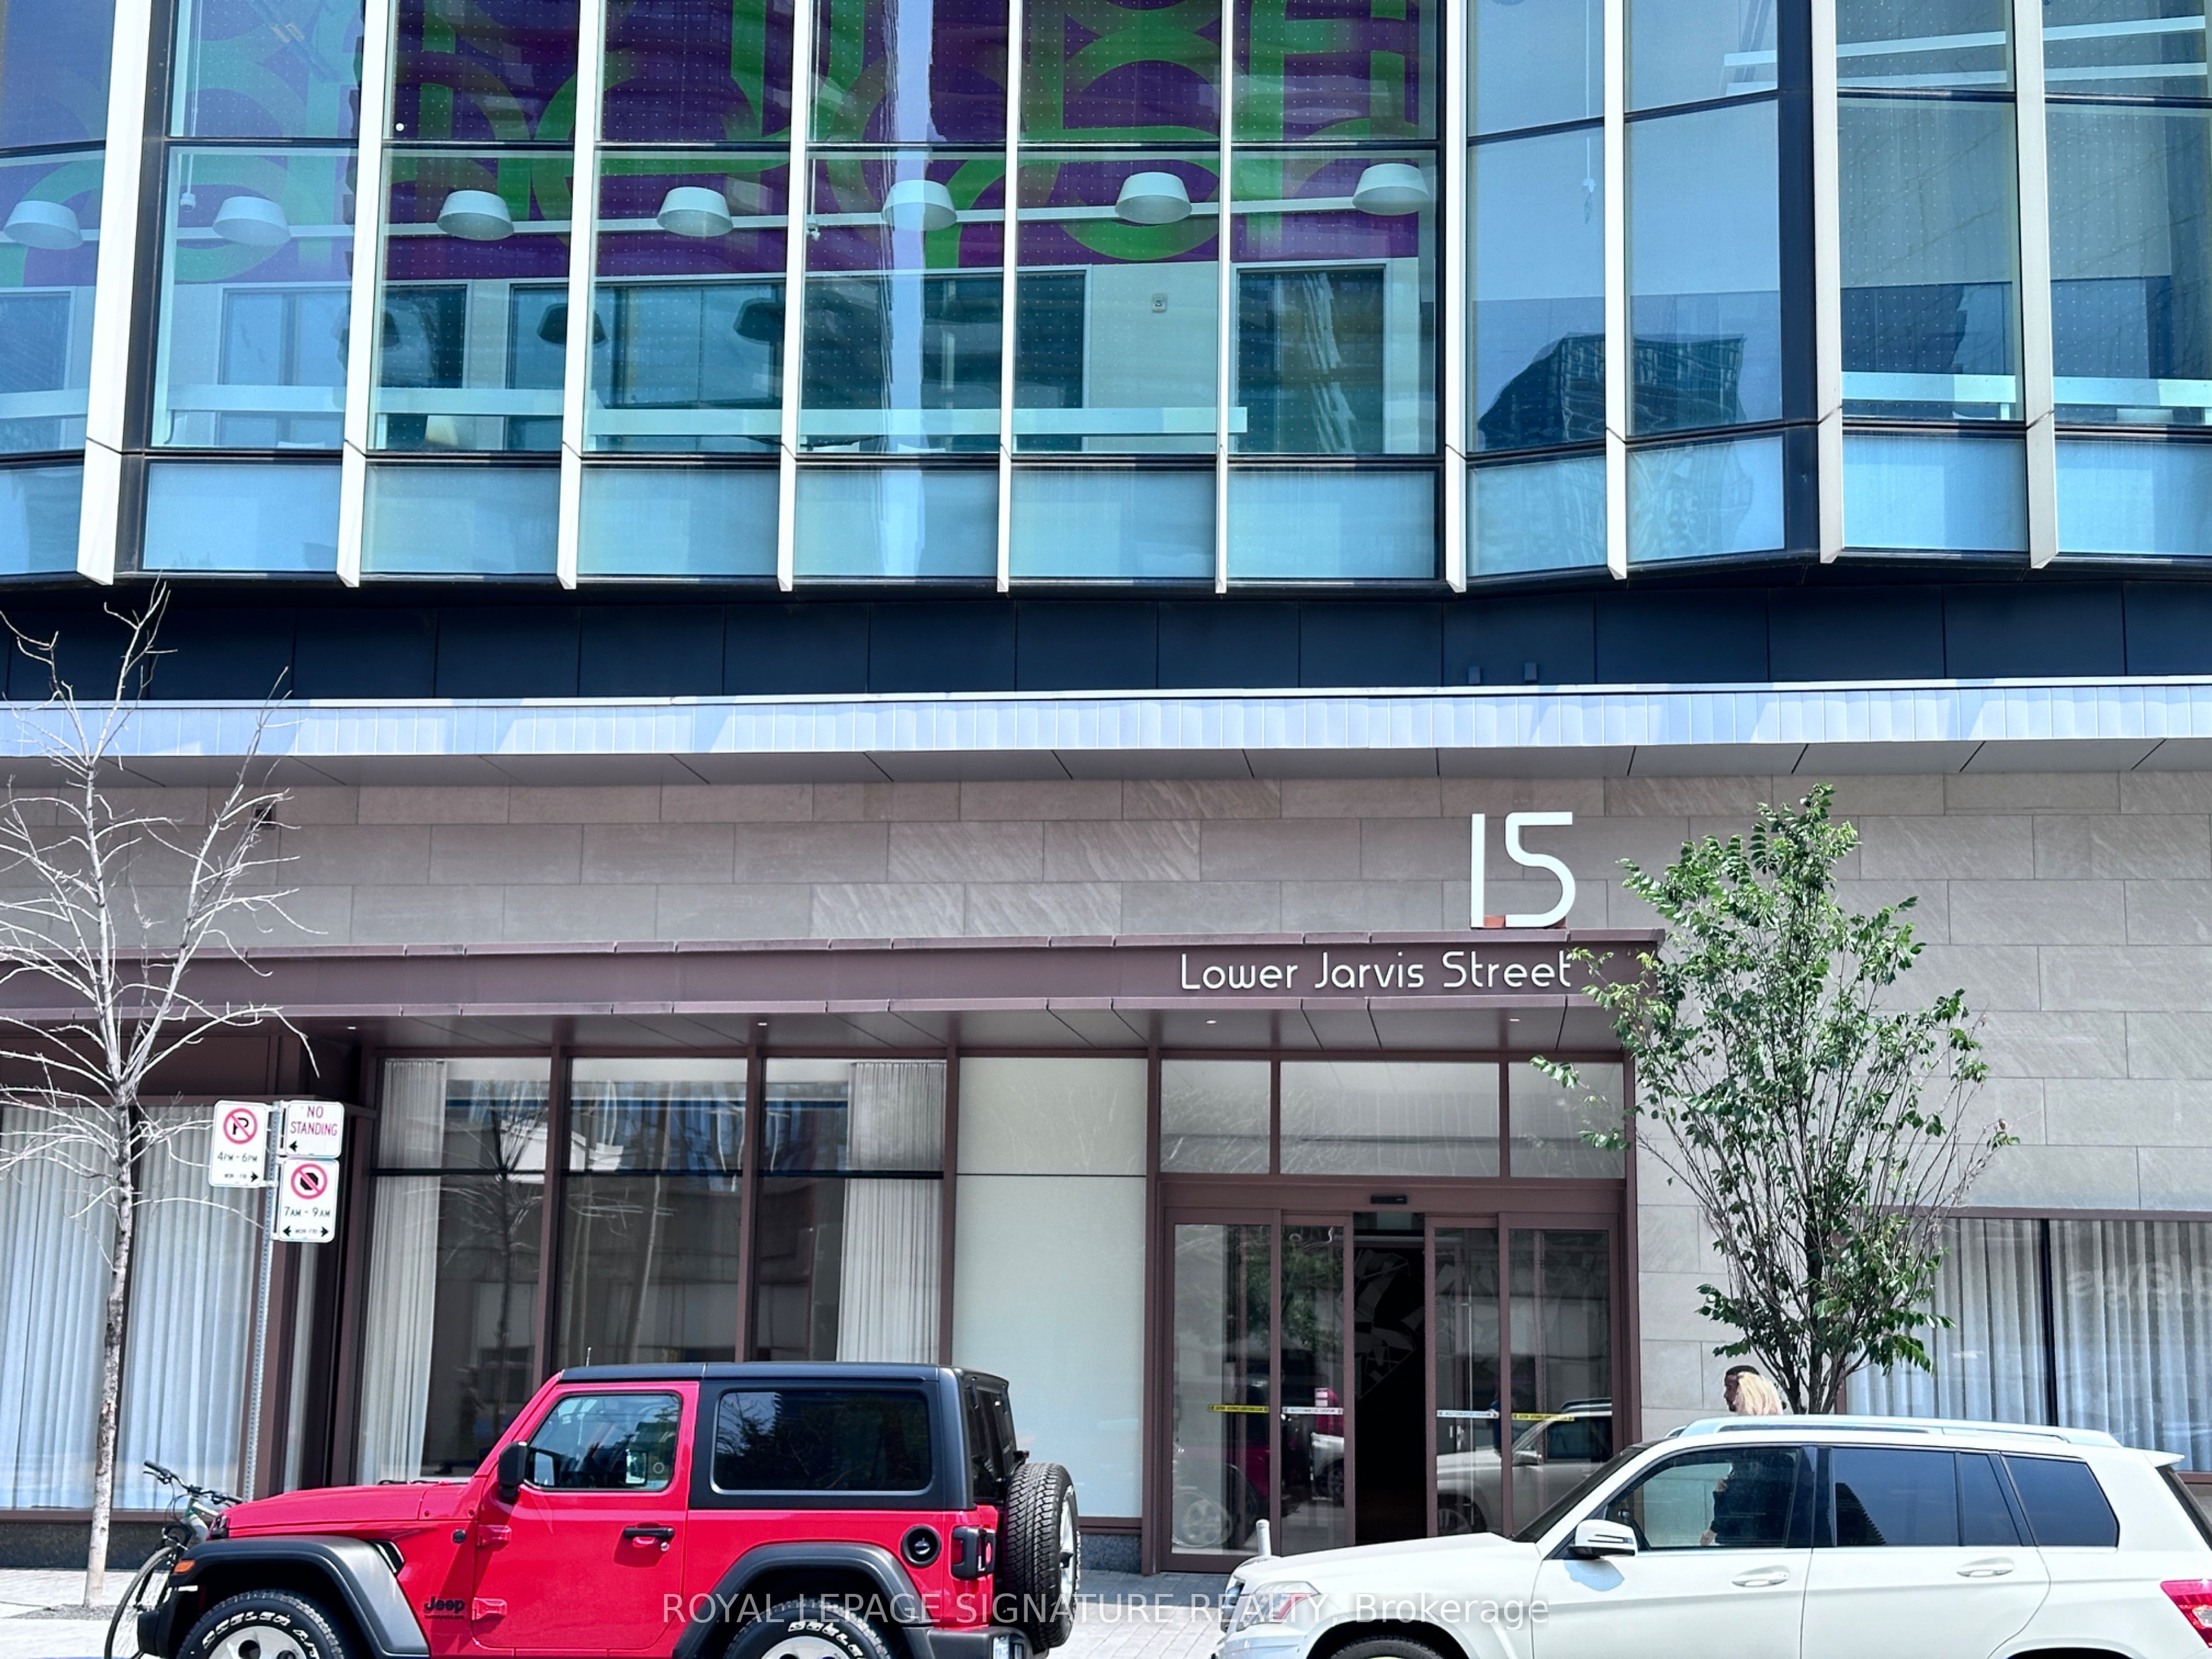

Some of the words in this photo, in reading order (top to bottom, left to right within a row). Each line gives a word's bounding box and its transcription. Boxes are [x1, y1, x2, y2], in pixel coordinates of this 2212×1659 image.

[1471, 811, 1576, 928] 15
[1181, 953, 1298, 989] Lower
[1314, 951, 1425, 988] Jarvis
[1442, 950, 1571, 988] Street
[306, 1105, 324, 1119] NO
[290, 1120, 338, 1137] STANDING
